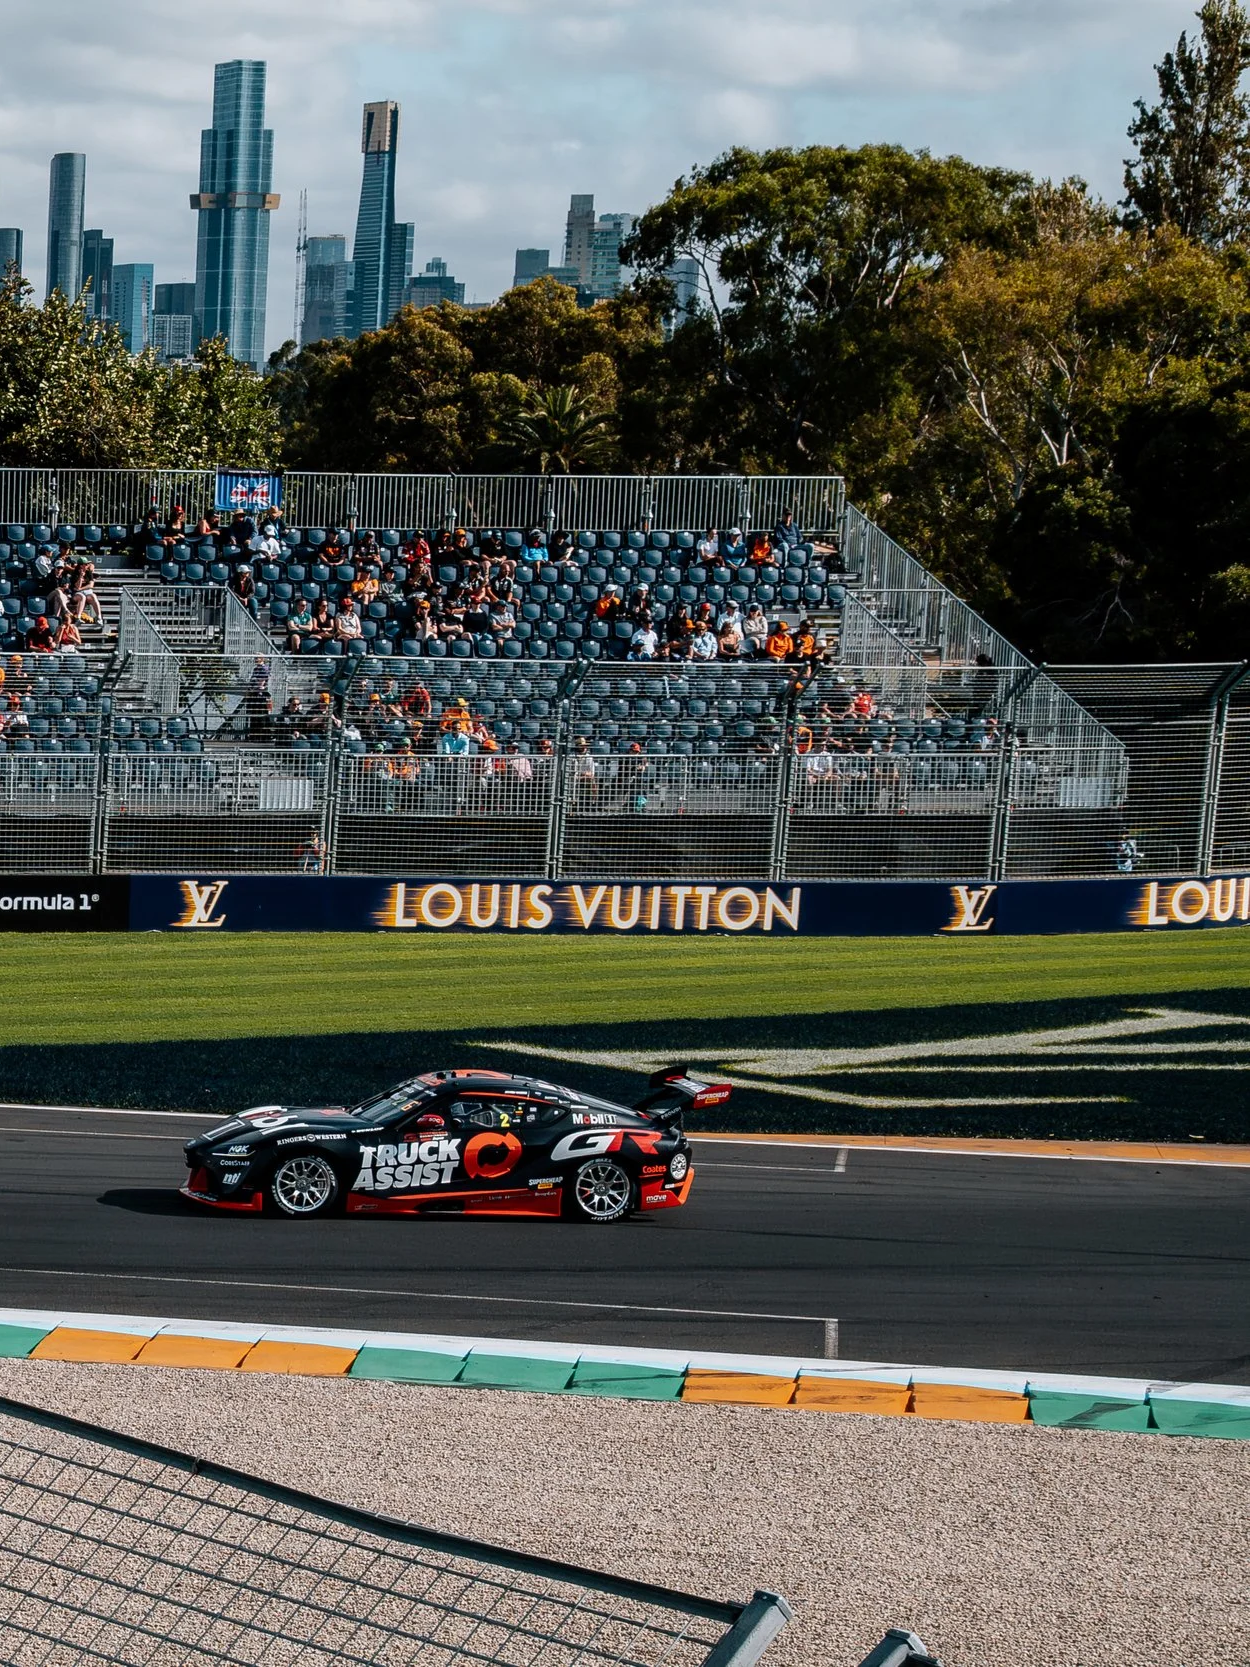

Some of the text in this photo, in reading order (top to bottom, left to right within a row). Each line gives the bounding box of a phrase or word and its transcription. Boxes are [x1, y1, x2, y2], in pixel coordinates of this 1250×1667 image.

[394, 883, 801, 931] LOUIS VUITTON
[499, 1113, 511, 1128] 2
[572, 1113, 604, 1125] Mobil
[276, 1133, 347, 1146] RINGERS WESTERN
[550, 1128, 663, 1161] GR
[228, 1145, 250, 1153] NGK
[359, 1138, 462, 1169] TRUCK
[351, 1160, 460, 1191] ASSIST
[642, 1165, 667, 1174] Coates
